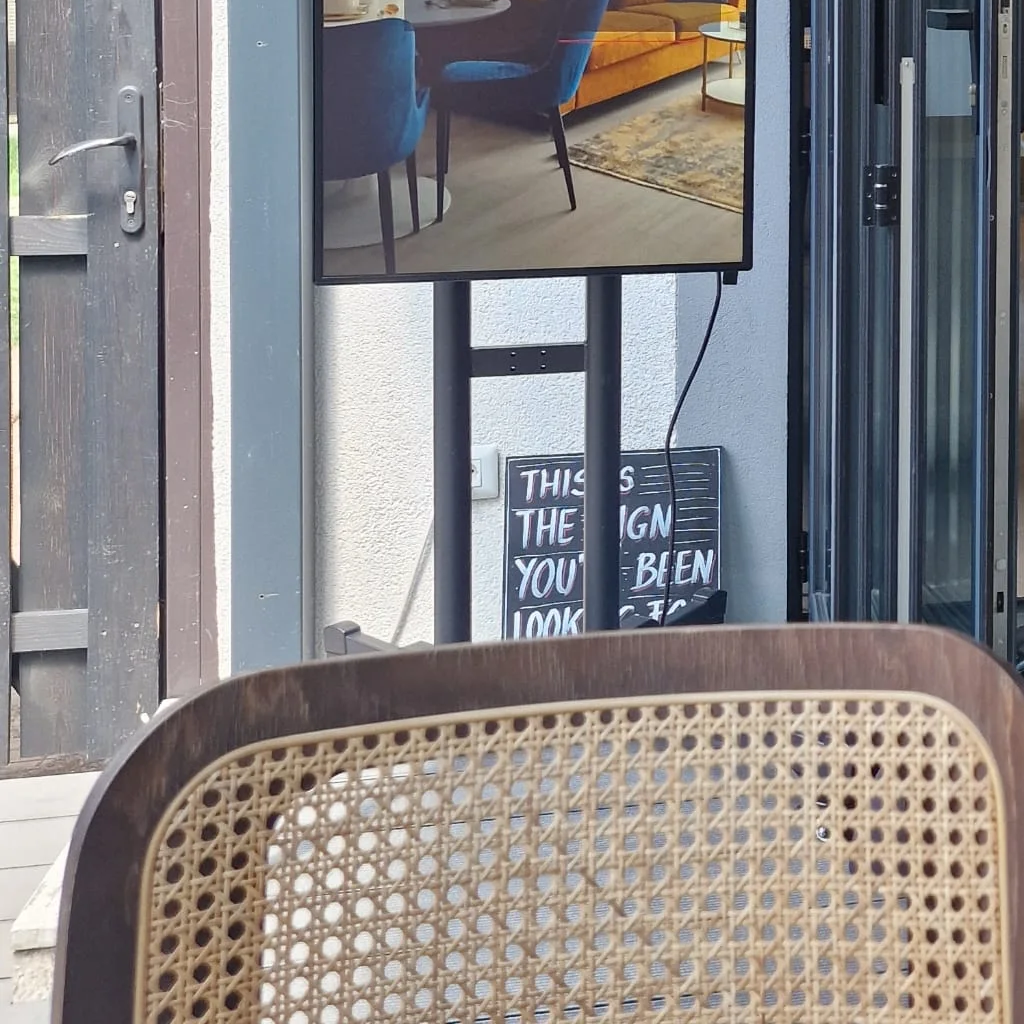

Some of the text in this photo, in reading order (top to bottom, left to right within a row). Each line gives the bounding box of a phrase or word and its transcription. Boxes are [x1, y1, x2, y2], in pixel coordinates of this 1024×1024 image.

[619, 465, 636, 492] S
[515, 503, 673, 550] THE IGN
[630, 549, 715, 591] BEEN
